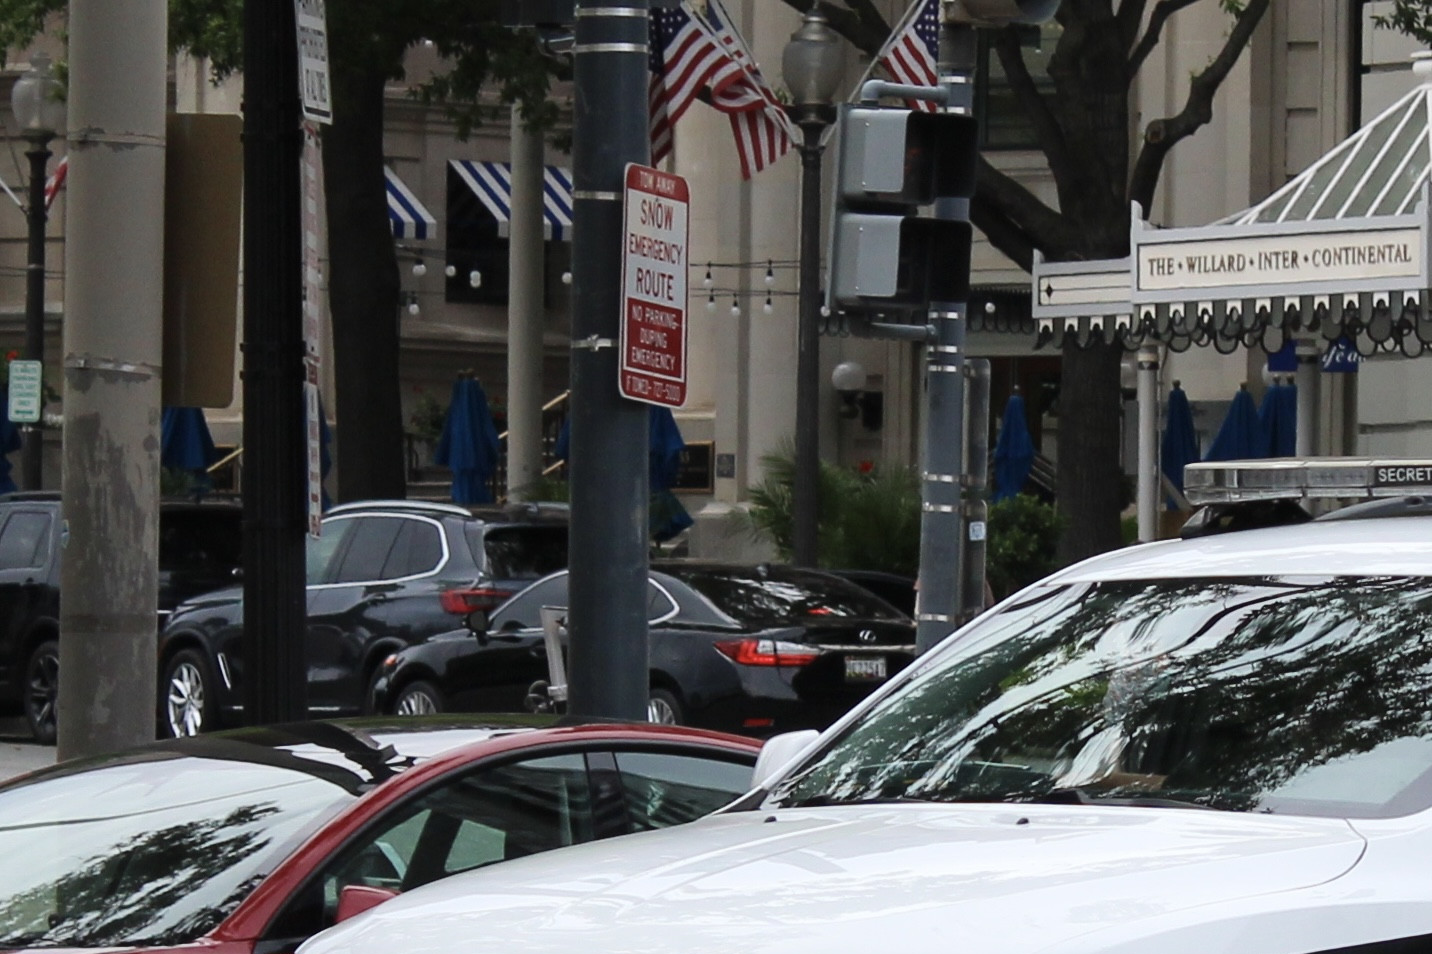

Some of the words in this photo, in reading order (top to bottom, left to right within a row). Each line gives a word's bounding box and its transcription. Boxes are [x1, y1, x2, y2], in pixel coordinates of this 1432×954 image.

[640, 170, 654, 190] TOW
[655, 176, 676, 195] AWAY
[640, 199, 674, 231] SNOW
[629, 233, 683, 265] EMERGENCY
[1148, 258, 1175, 276] THE
[1186, 254, 1246, 274] WILLARD
[1258, 250, 1300, 270] INTER
[1312, 244, 1412, 267] CONTINENTAL
[636, 267, 674, 301] ROUTE
[632, 304, 643, 322] NO
[640, 327, 668, 349] DURING
[632, 346, 676, 371] EMERGENCY
[1378, 467, 1432, 482] SECRET
